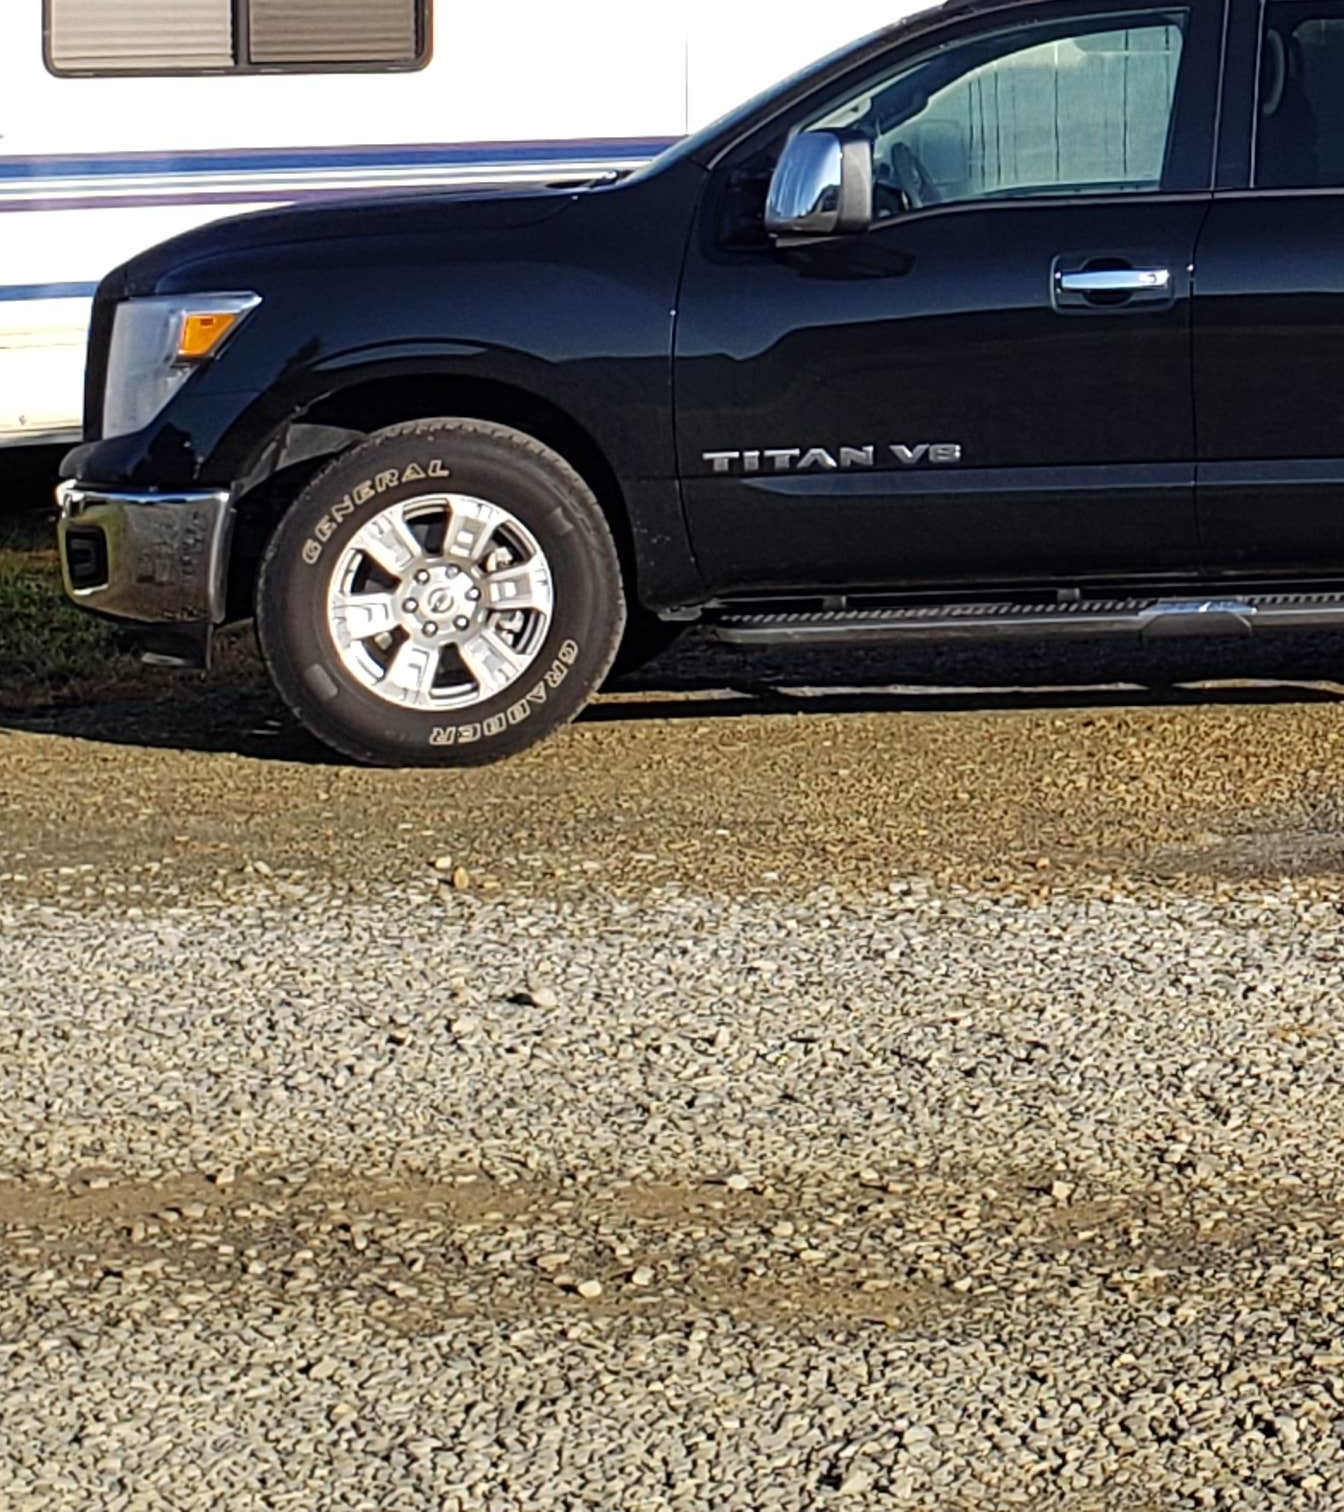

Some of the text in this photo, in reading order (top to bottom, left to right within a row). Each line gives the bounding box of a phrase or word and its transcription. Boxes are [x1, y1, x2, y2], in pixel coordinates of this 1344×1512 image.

[702, 443, 961, 472] TITAN V8
[302, 459, 450, 564] GENERAL
[429, 638, 579, 746] GRABBER
